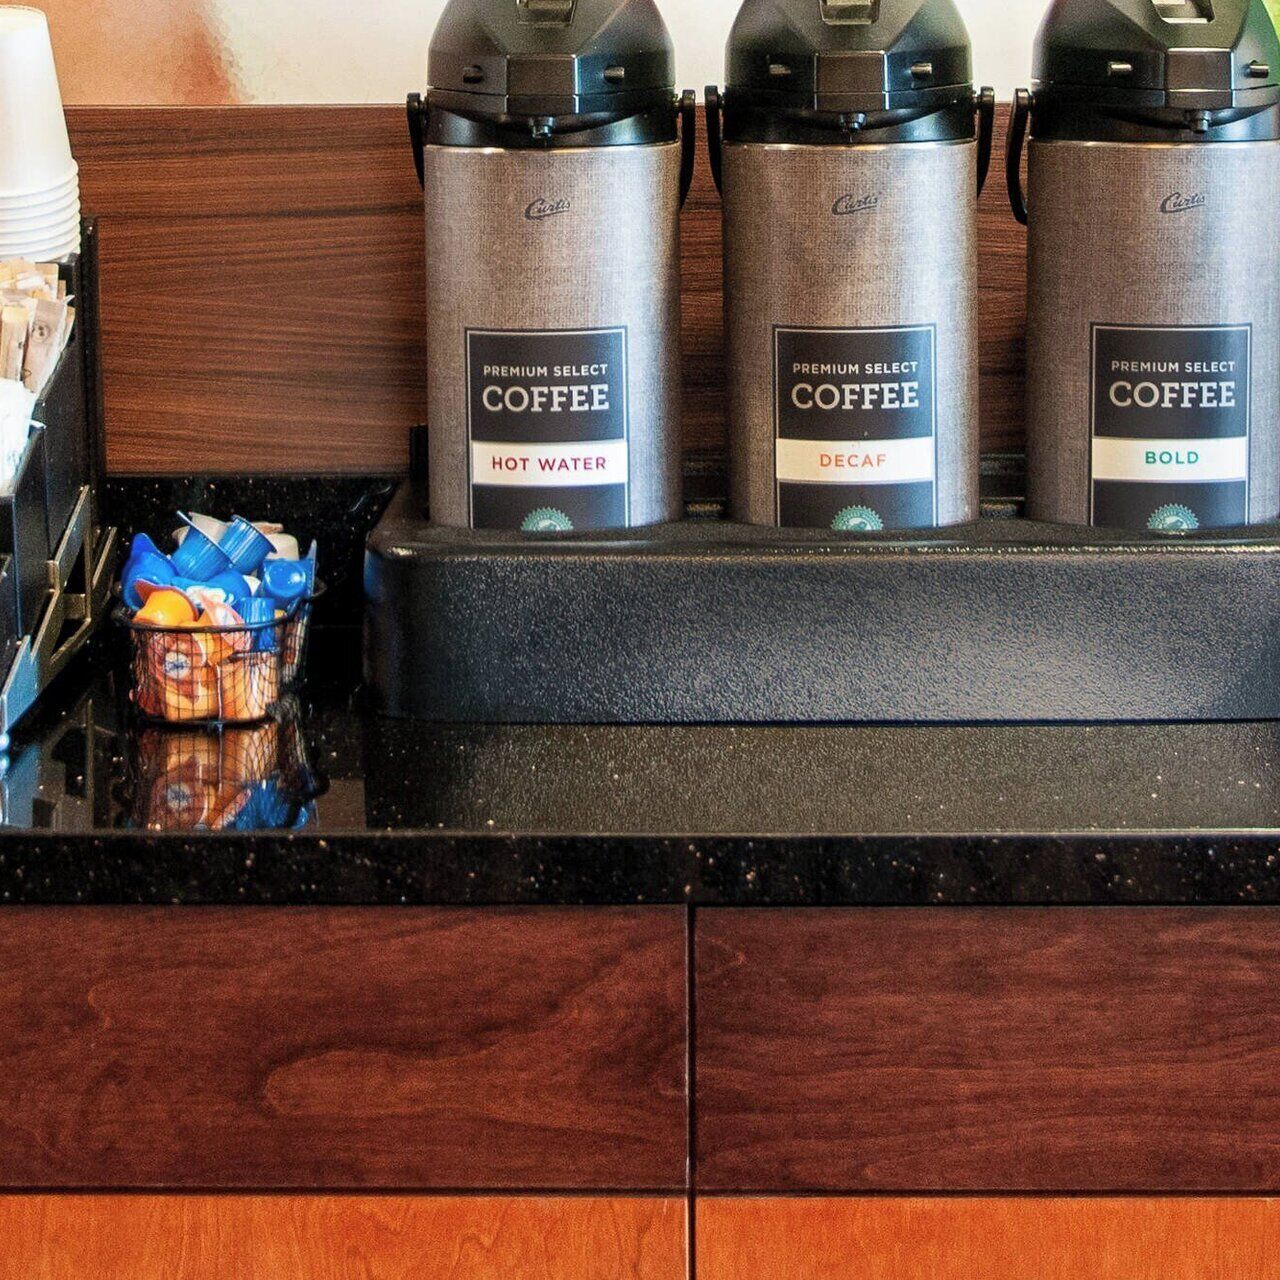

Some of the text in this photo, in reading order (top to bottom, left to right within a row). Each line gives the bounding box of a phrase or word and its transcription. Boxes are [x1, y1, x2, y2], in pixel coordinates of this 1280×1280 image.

[524, 197, 571, 220] Curtis
[832, 194, 878, 216] Curtis
[1160, 191, 1205, 214] Curtis
[483, 363, 608, 377] PREMIUM SELECT
[793, 361, 918, 374] PREMIUM SELECT
[1111, 360, 1235, 373] PREMIUM SELECT
[482, 383, 609, 412] COFFEE
[791, 382, 919, 410] COFFEE
[1109, 381, 1236, 408] COFFEE
[492, 455, 606, 471] HOT WATER
[819, 453, 887, 468] DECAF
[1144, 450, 1199, 465] BOLD
